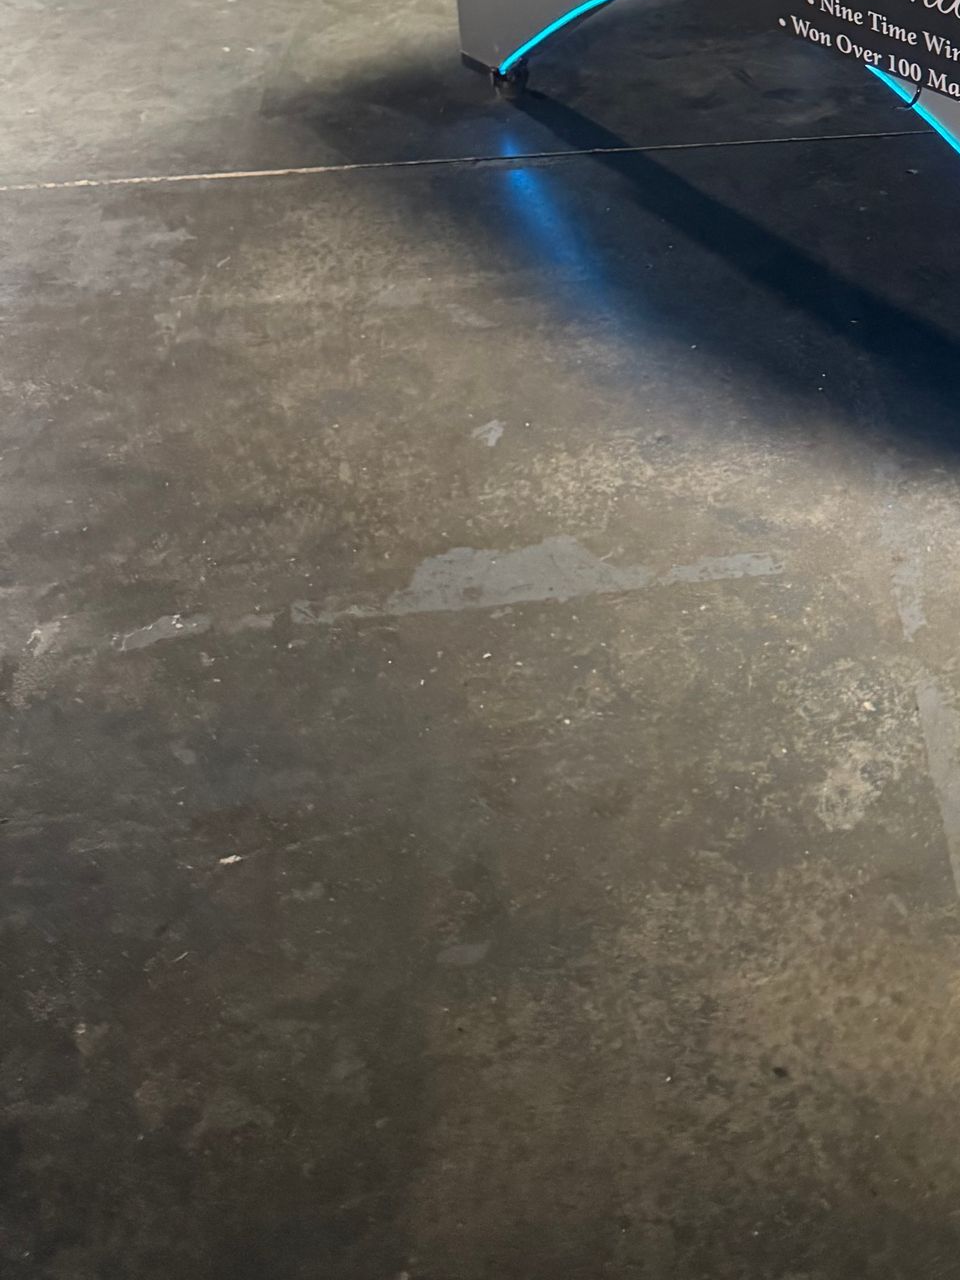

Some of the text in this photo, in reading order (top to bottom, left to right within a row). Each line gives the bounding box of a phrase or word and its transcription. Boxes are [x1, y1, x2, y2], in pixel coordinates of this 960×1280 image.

[790, 14, 832, 47] Won
[836, 34, 883, 66] Over
[888, 54, 922, 82] 100
[868, 10, 918, 46] Time
